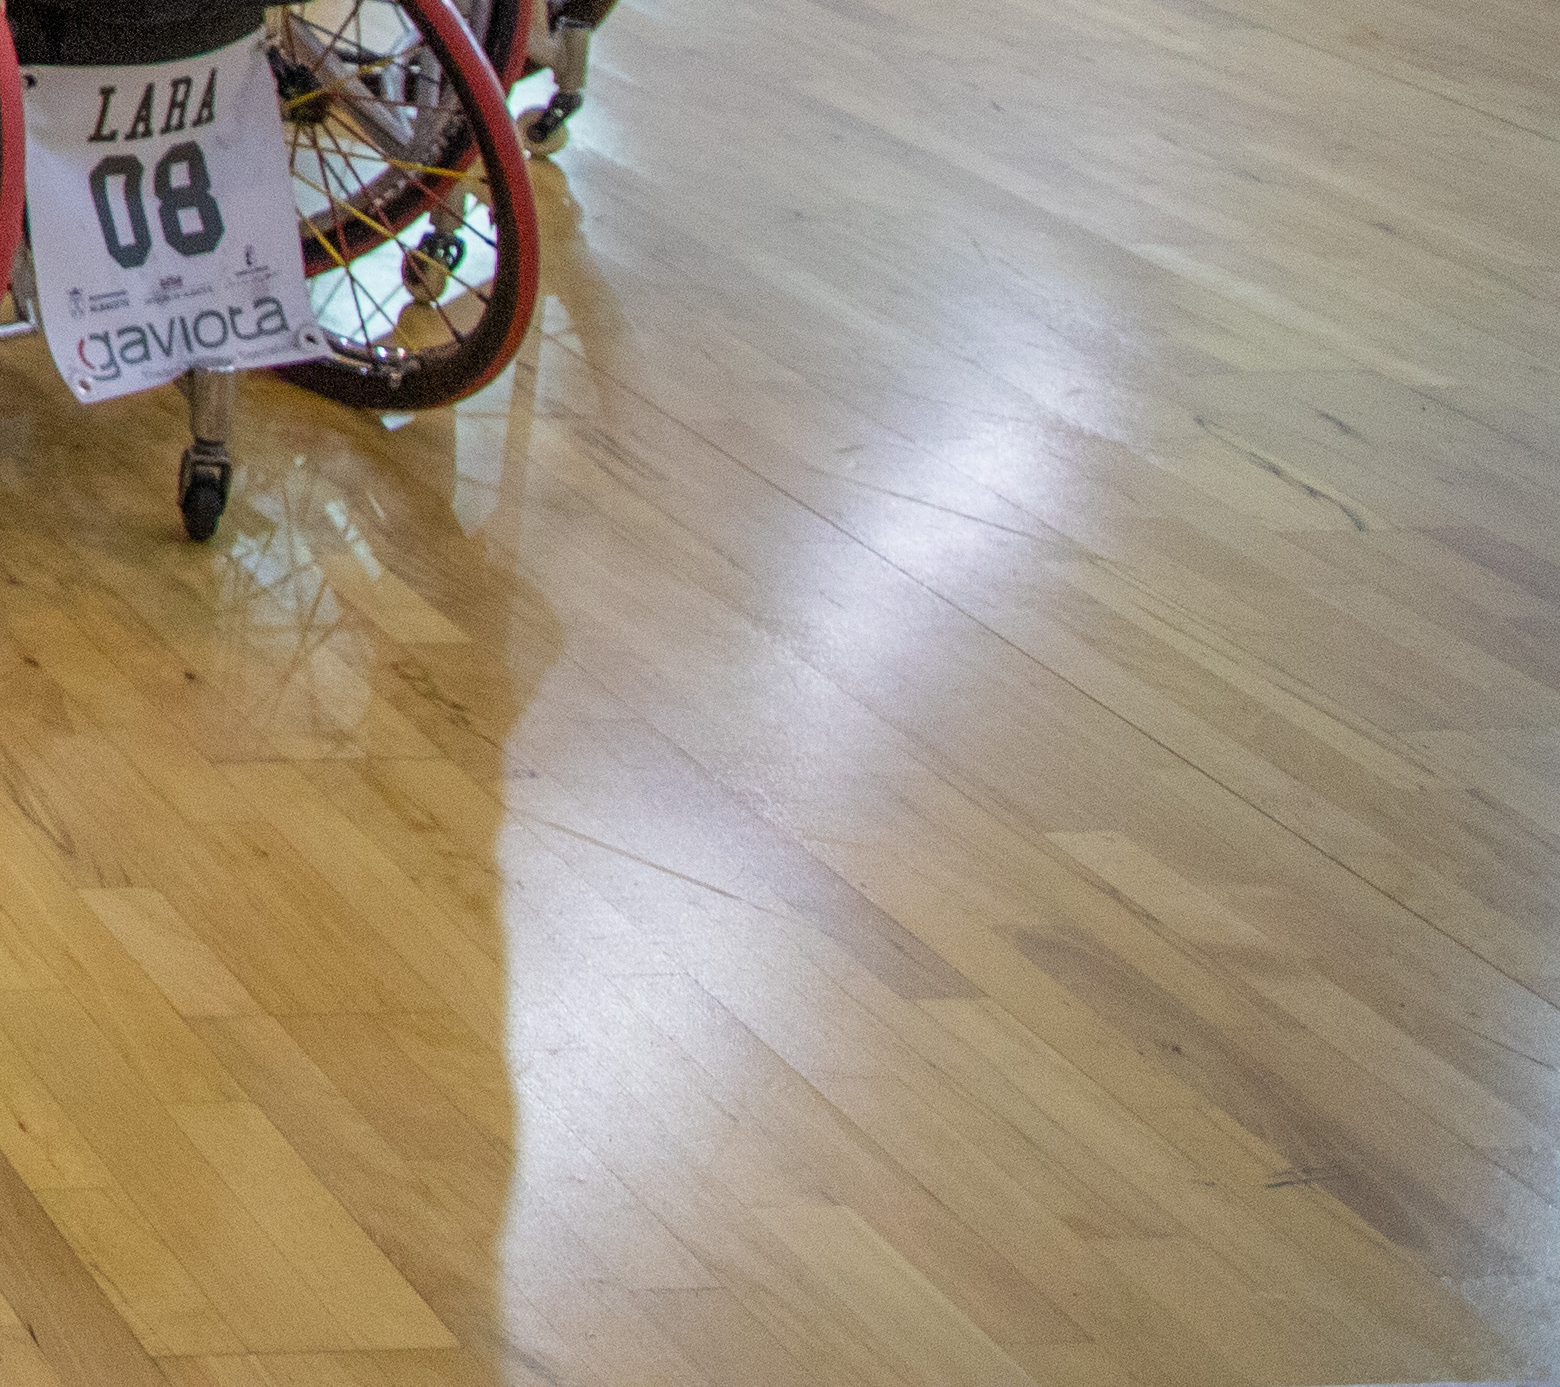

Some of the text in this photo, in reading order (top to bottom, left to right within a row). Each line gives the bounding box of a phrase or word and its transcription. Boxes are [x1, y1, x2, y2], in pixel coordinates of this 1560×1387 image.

[87, 68, 218, 144] LARA
[89, 141, 225, 269] 08
[77, 296, 290, 381] gaviota
